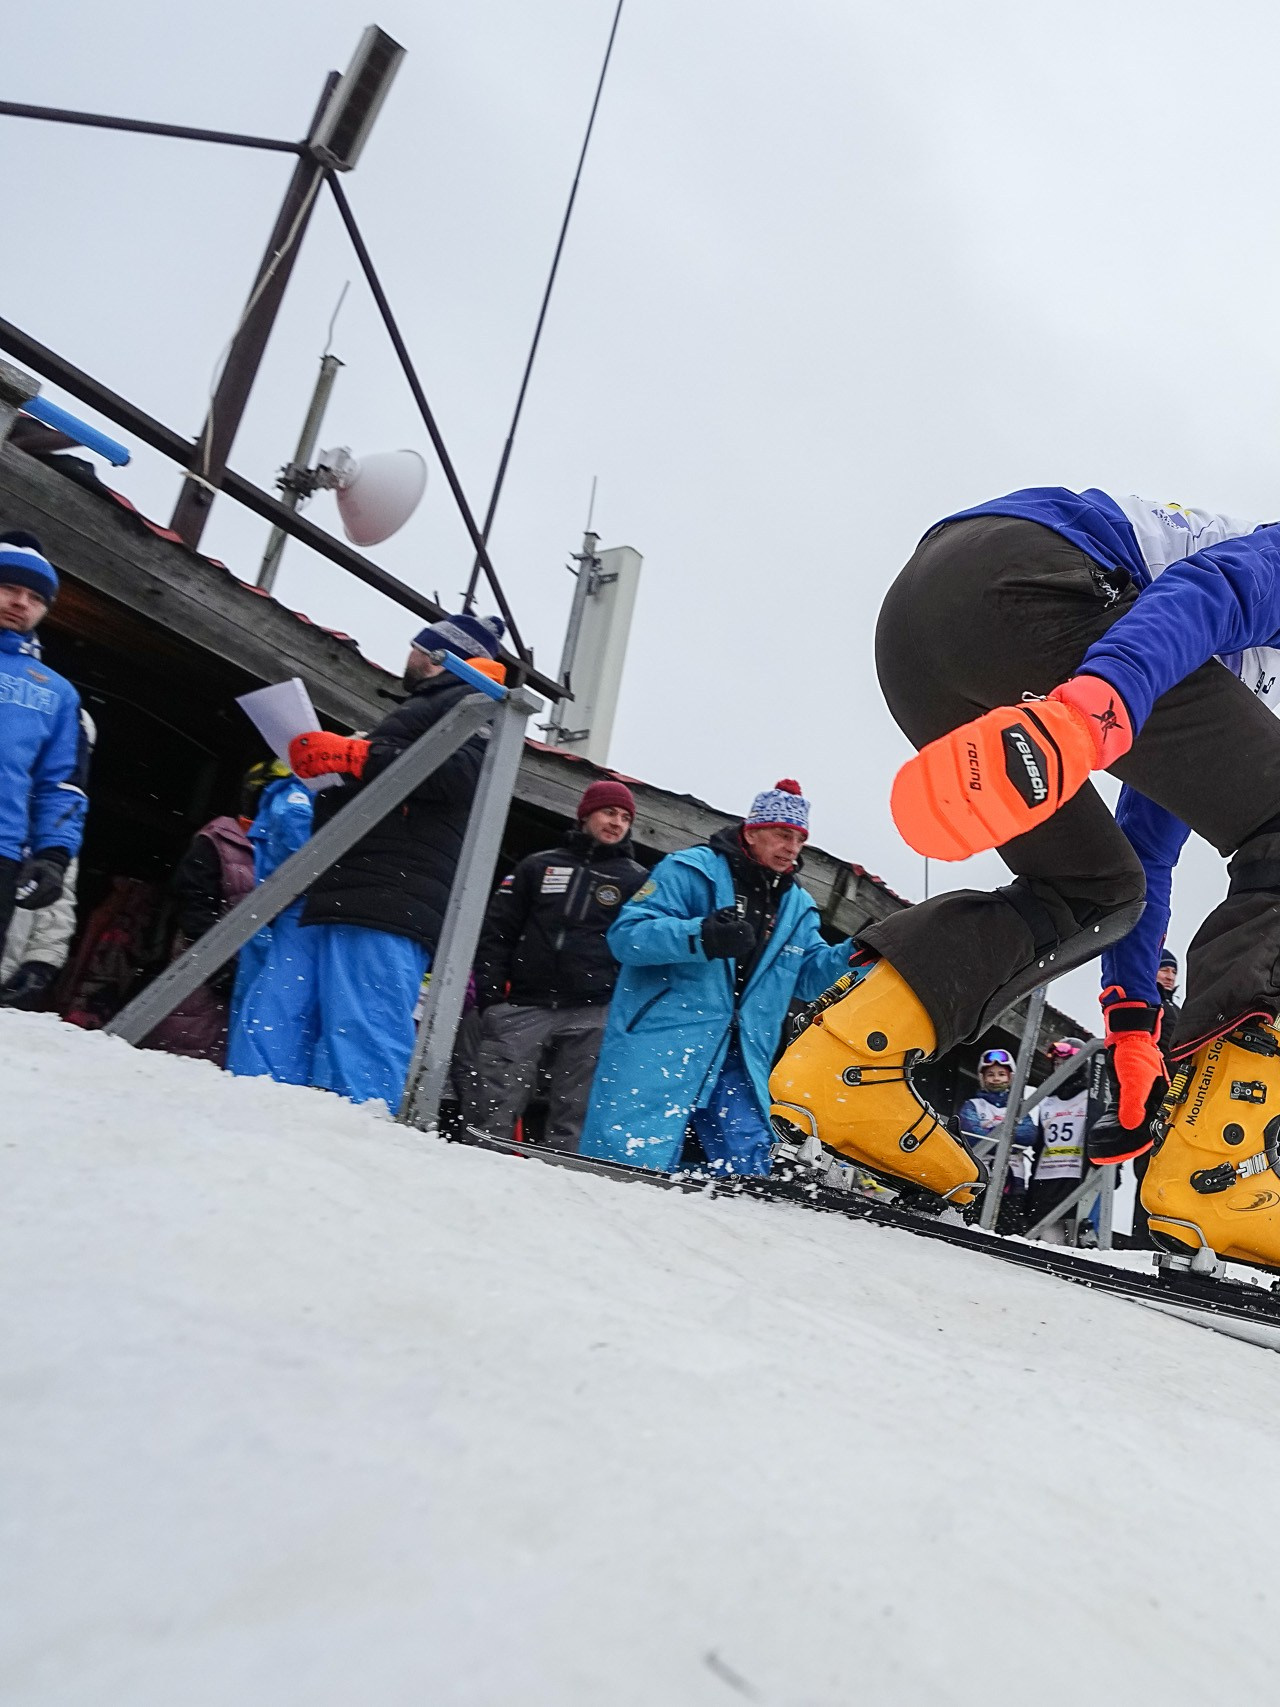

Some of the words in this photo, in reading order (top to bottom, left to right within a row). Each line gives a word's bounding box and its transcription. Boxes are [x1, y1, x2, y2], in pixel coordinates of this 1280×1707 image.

[967, 742, 982, 791] racing
[1009, 732, 1048, 801] reusch
[1185, 1065, 1216, 1126] Mountain
[1207, 1036, 1228, 1062] Slop
[1047, 1122, 1074, 1143] 35
